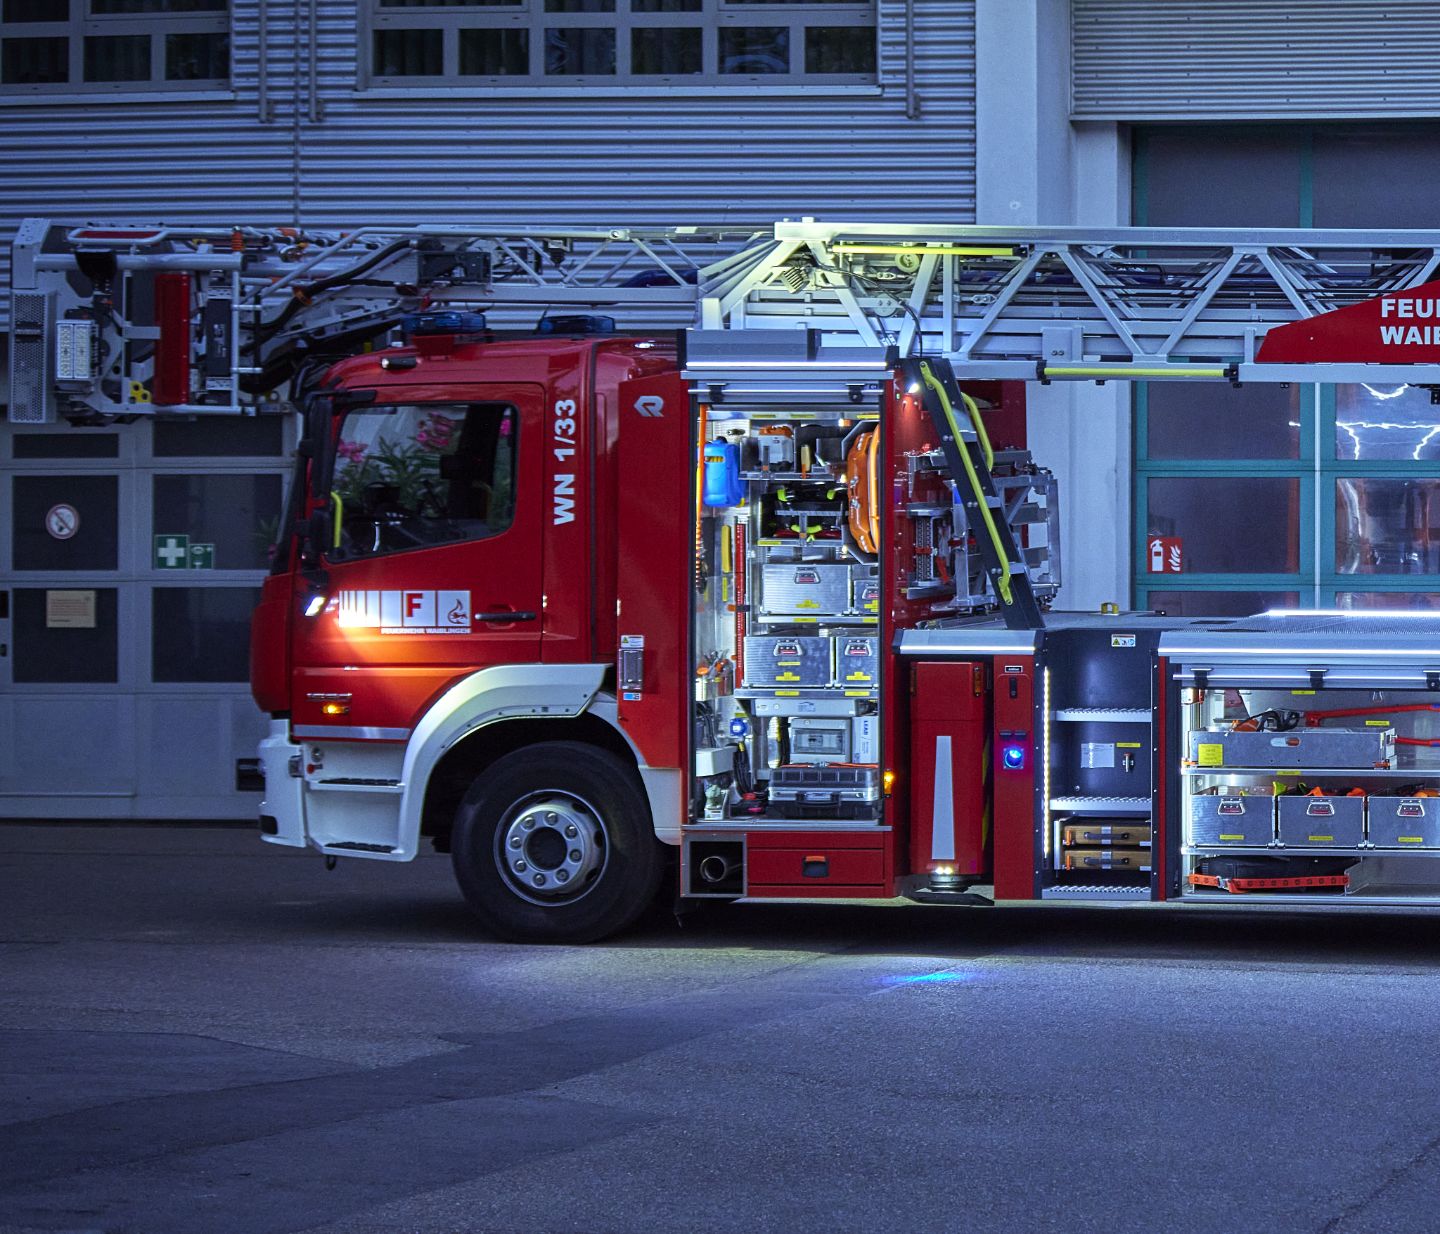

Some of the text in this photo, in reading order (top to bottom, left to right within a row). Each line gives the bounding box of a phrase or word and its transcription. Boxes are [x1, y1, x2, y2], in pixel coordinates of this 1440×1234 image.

[553, 399, 577, 526] WN 1/33
[405, 593, 423, 618] F
